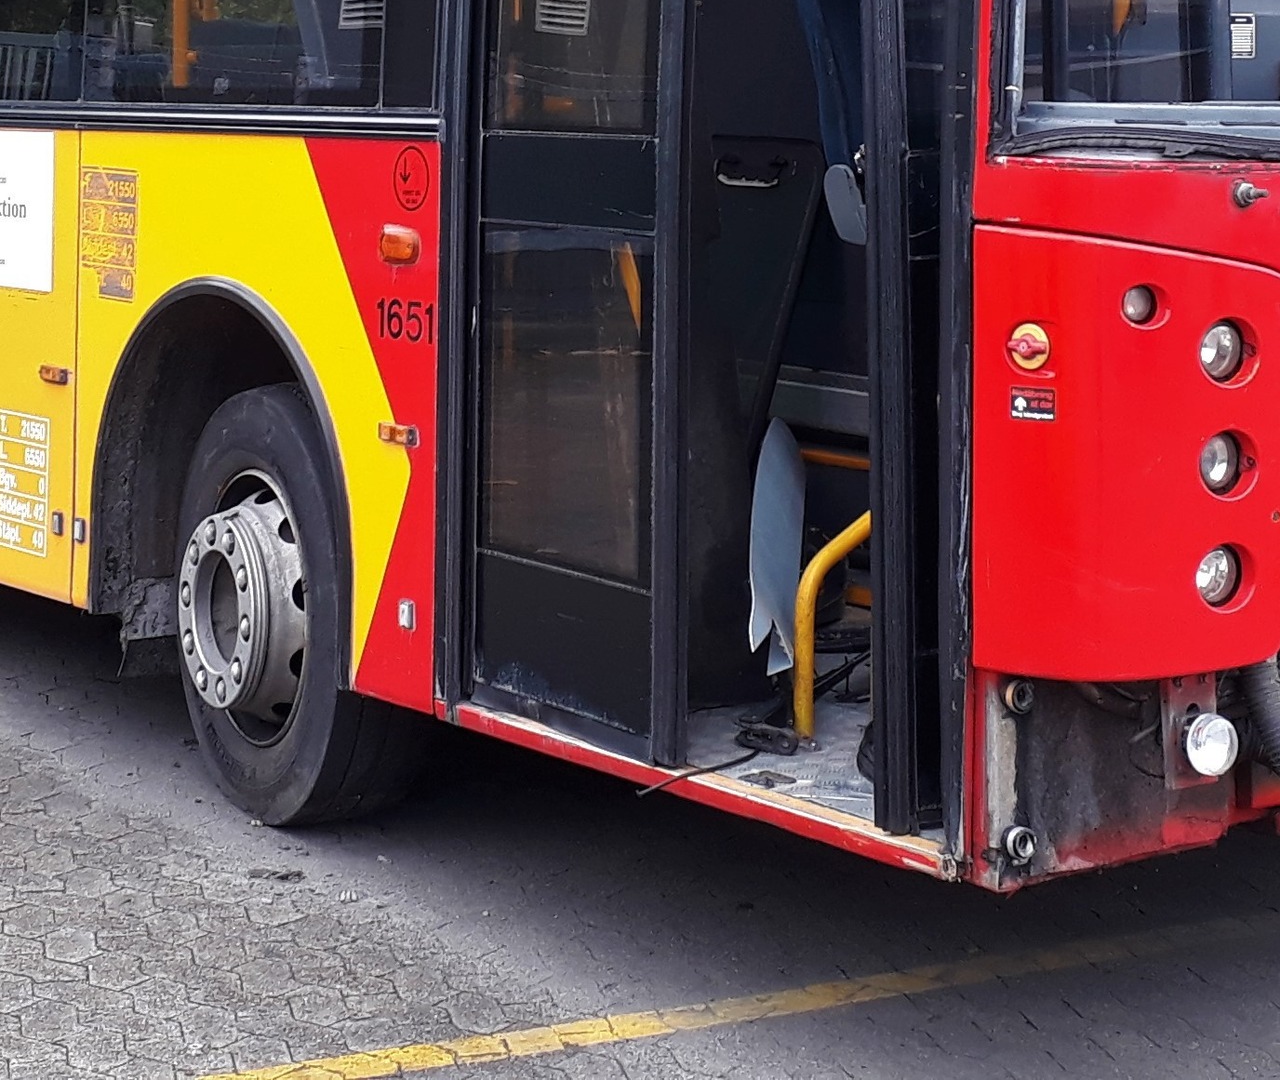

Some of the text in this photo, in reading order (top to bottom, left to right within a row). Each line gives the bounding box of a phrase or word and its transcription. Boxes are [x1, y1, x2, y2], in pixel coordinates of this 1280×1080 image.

[108, 179, 135, 199] 21550
[120, 274, 132, 291] 40
[376, 297, 434, 345] 1651
[21, 419, 46, 441] 21550
[24, 446, 46, 469] 6550
[33, 503, 45, 522] 42
[32, 528, 45, 550] 40
